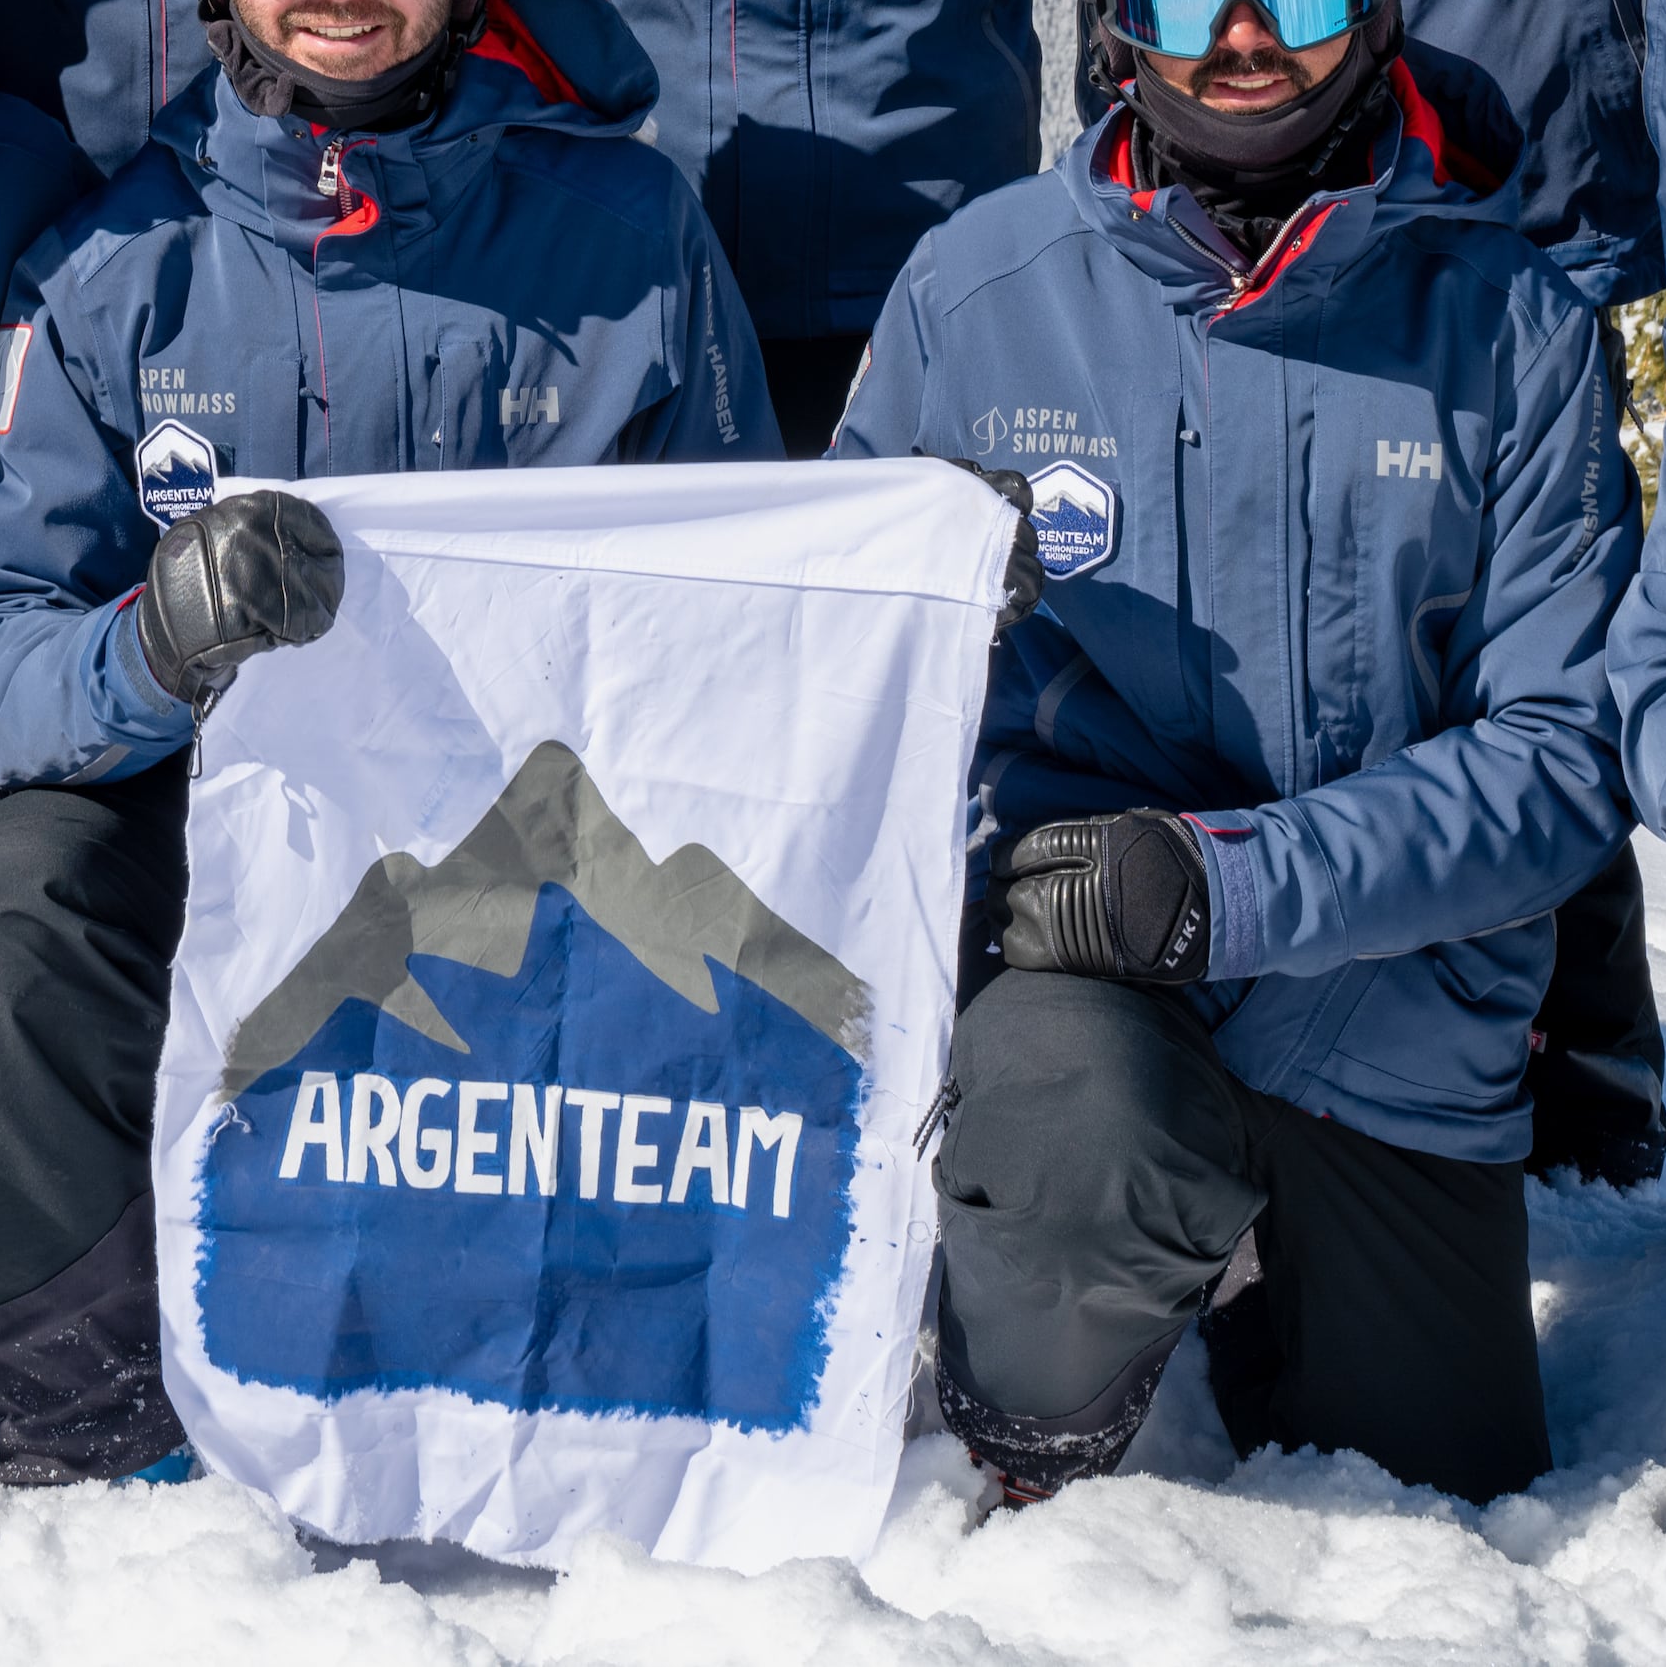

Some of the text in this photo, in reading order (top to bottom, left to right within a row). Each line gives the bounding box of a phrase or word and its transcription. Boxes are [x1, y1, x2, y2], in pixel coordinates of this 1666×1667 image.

[139, 368, 185, 390] SPEN
[141, 392, 236, 414] NOWMASS
[498, 386, 560, 426] HH
[706, 343, 741, 445] HANSEN
[1014, 408, 1078, 431] ASPEN
[1588, 373, 1603, 455] HELLY
[1013, 433, 1118, 458] SNOWMASS
[1376, 439, 1442, 480] HH
[146, 487, 214, 502] ARGENTEAM
[1037, 530, 1104, 546] GENTEAM
[1038, 543, 1090, 555] NCHRONIZED
[1164, 908, 1200, 968] LEKI
[278, 1071, 803, 1218] ARGENTEAM
